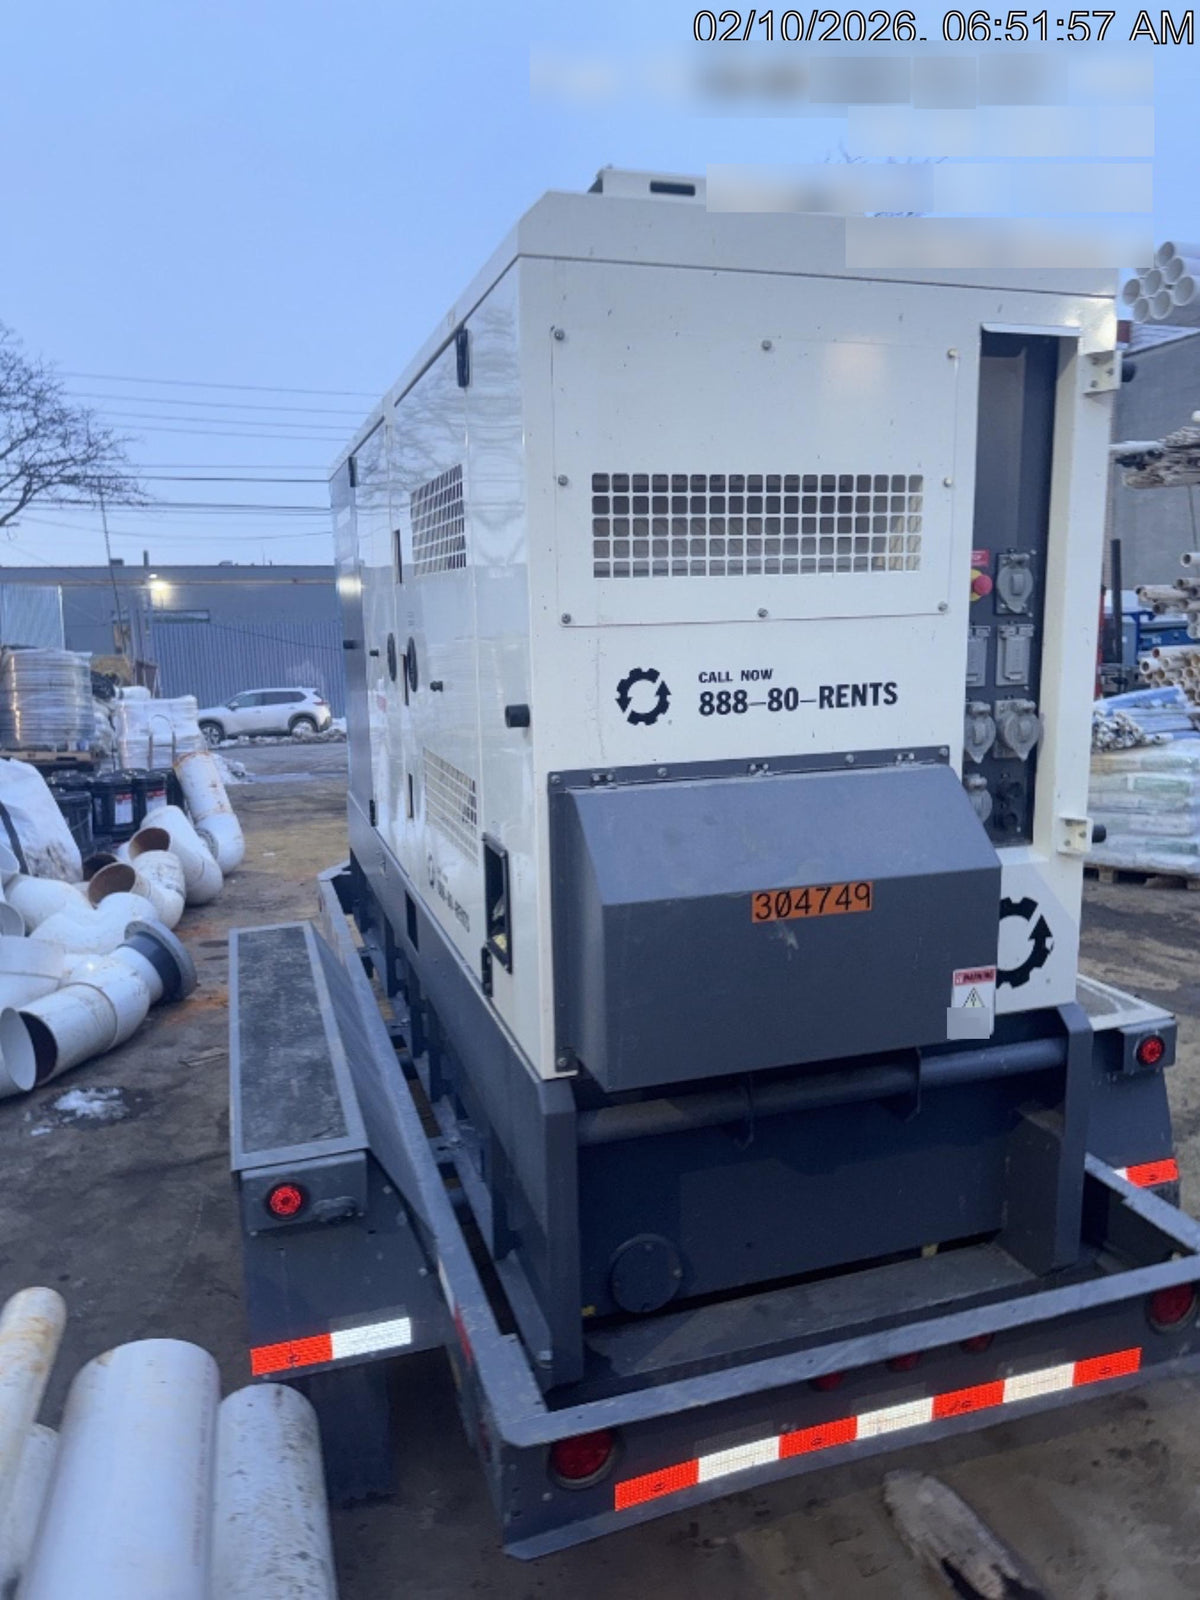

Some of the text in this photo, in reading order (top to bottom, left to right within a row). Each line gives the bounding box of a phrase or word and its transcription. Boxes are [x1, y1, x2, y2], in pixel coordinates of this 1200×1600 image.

[698, 668, 773, 683] CALL NOW
[698, 681, 898, 716] 888-80-RENTS
[755, 882, 871, 920] 304749
